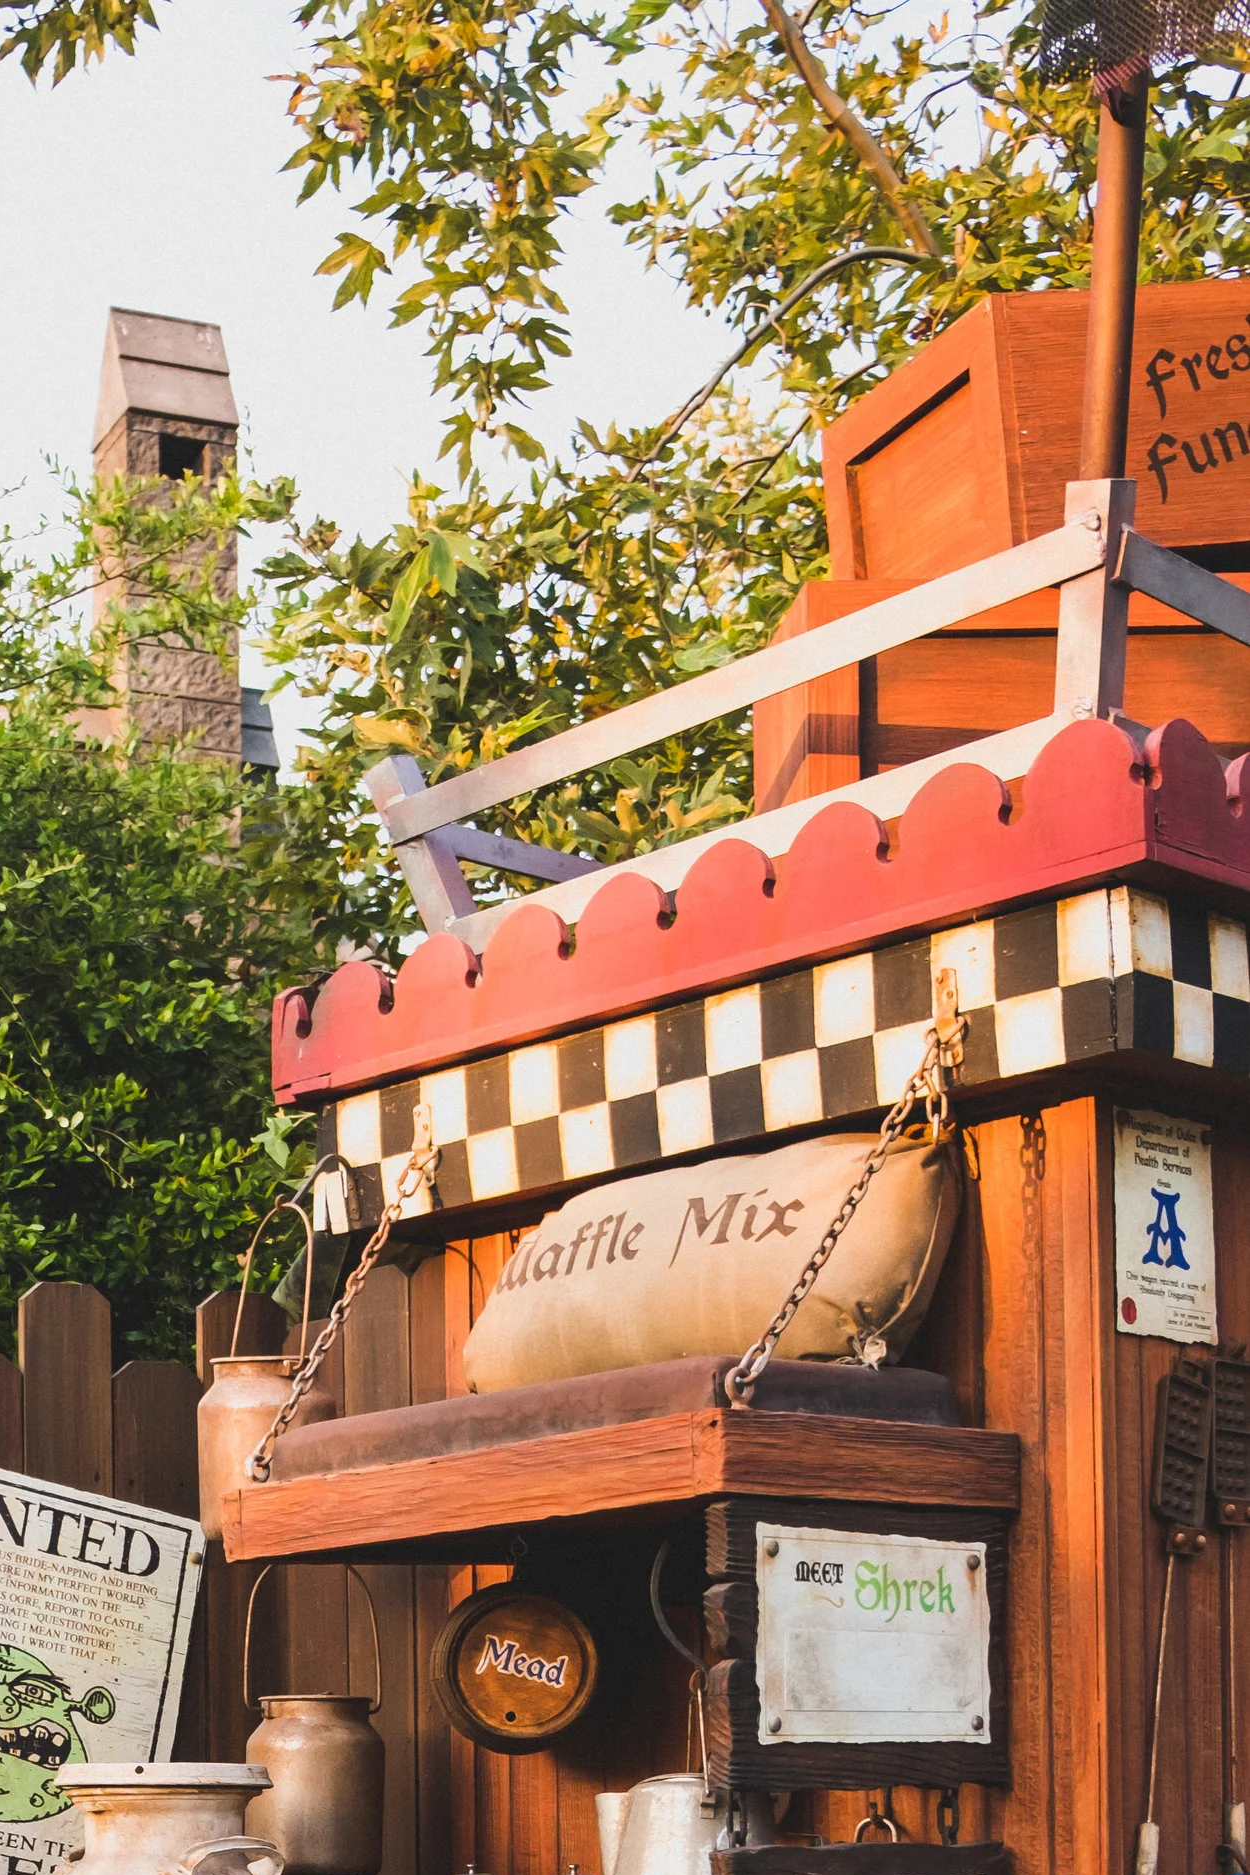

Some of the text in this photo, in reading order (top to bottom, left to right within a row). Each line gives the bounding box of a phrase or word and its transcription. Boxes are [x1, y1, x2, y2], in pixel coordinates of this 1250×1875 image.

[1145, 313, 1250, 421] fres
[1147, 421, 1250, 504] fun
[668, 1187, 806, 1269] Mix
[1141, 1187, 1191, 1271] A
[14, 1554, 98, 1582] BRIDE-NAPPING
[99, 1575, 124, 1588] AND
[22, 1568, 36, 1580] IN
[37, 1572, 55, 1585] MY
[57, 1577, 105, 1597] PERFECT
[4, 1577, 81, 1605] INFORMATION
[81, 1596, 98, 1609] ON
[100, 1600, 122, 1614] THE
[794, 1559, 956, 1623] MEET Shrek
[43, 1600, 86, 1619] REPORT
[87, 1611, 103, 1623] TO
[103, 1615, 145, 1633] CASTLE
[28, 1623, 63, 1639] MEAN
[63, 1631, 116, 1652] TORTURE!
[28, 1636, 67, 1654] WROTE
[477, 1636, 567, 1687] Mead
[44, 1839, 75, 1858] TH
